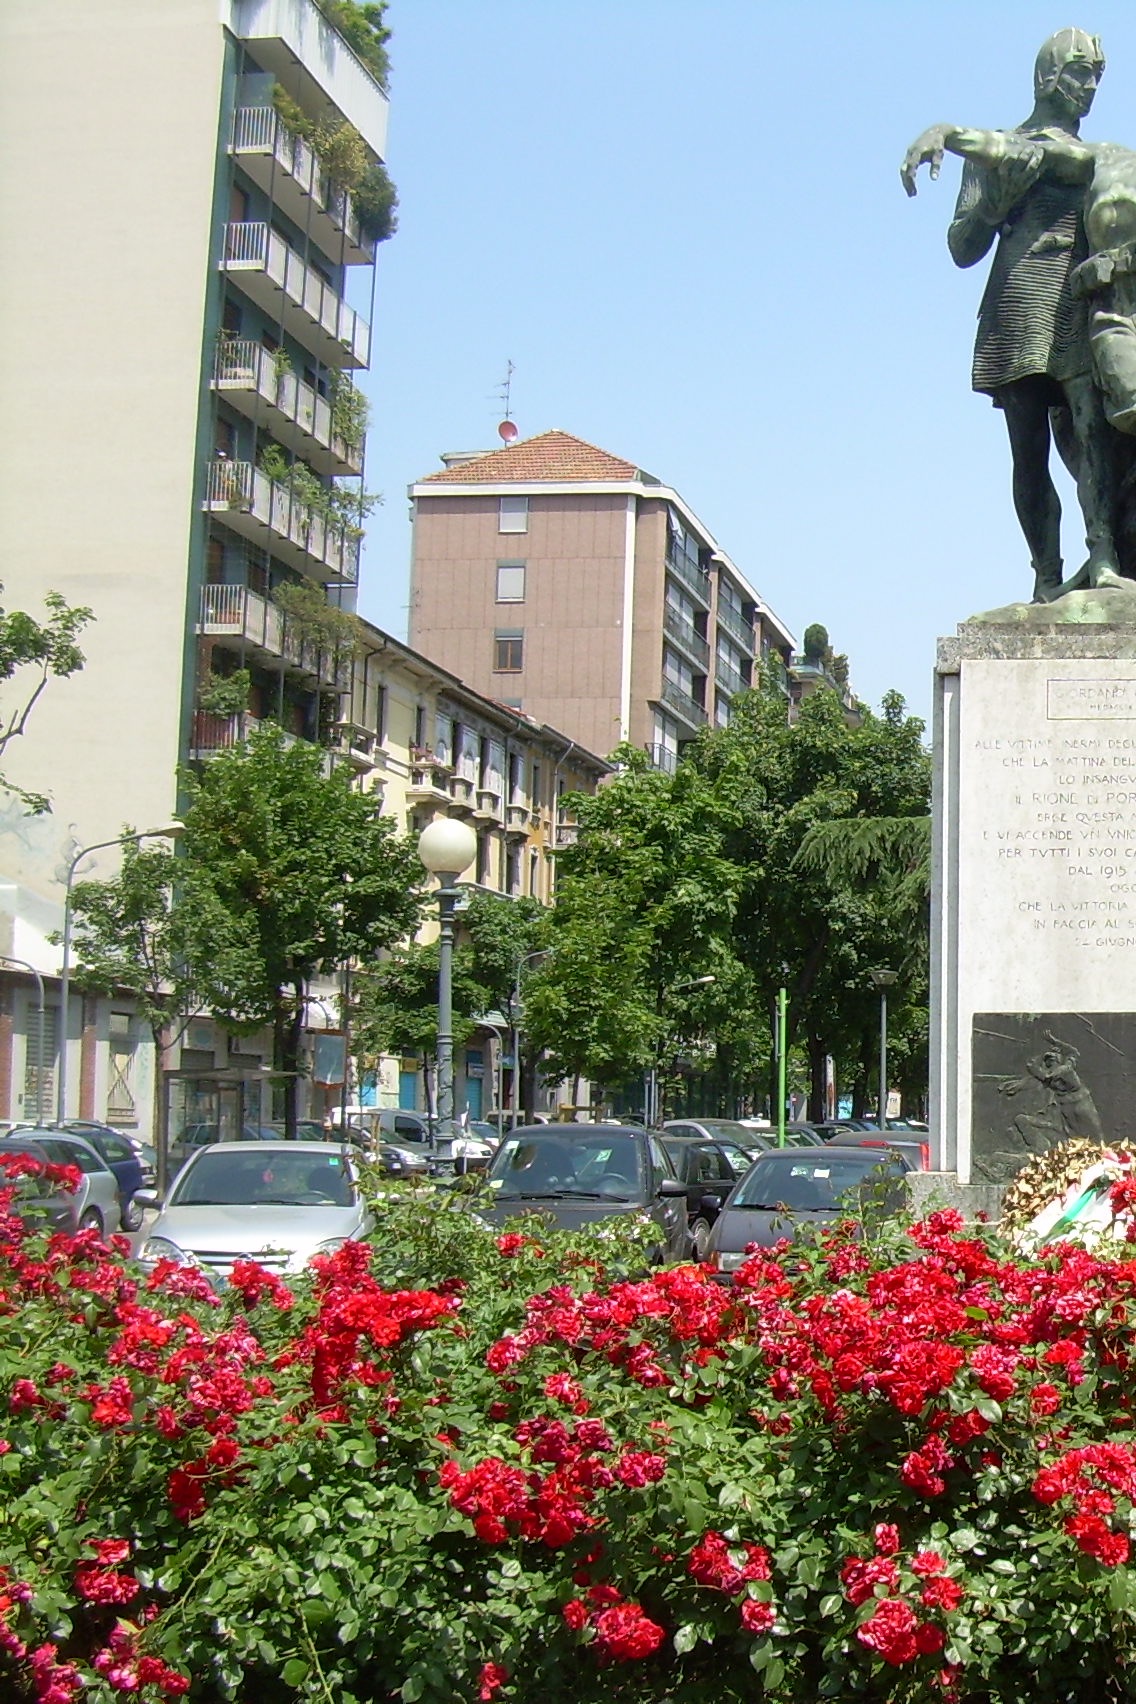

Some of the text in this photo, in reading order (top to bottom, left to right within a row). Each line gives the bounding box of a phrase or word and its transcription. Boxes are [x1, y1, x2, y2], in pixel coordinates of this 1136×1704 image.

[975, 740, 1001, 749] ALLE
[1002, 757, 1024, 767] CHE
[1033, 757, 1049, 767] LA
[1113, 757, 1135, 767] DEL
[1059, 774, 1076, 784] LO
[1032, 792, 1079, 805] RIONE
[1075, 812, 1124, 825] QVESTA
[1015, 830, 1073, 840] ACCENDE
[998, 848, 1022, 858] PER
[1028, 848, 1070, 858] TVTTI
[1087, 848, 1117, 857] SVOI
[1068, 866, 1093, 876] DAL
[1100, 866, 1127, 879] 1915
[1018, 901, 1042, 911] CHE
[1050, 901, 1066, 911] LA
[1072, 901, 1128, 911] VITTORIA
[1034, 919, 1046, 929] IN
[1053, 919, 1097, 929] FACCIA
[1104, 919, 1120, 929] AL
